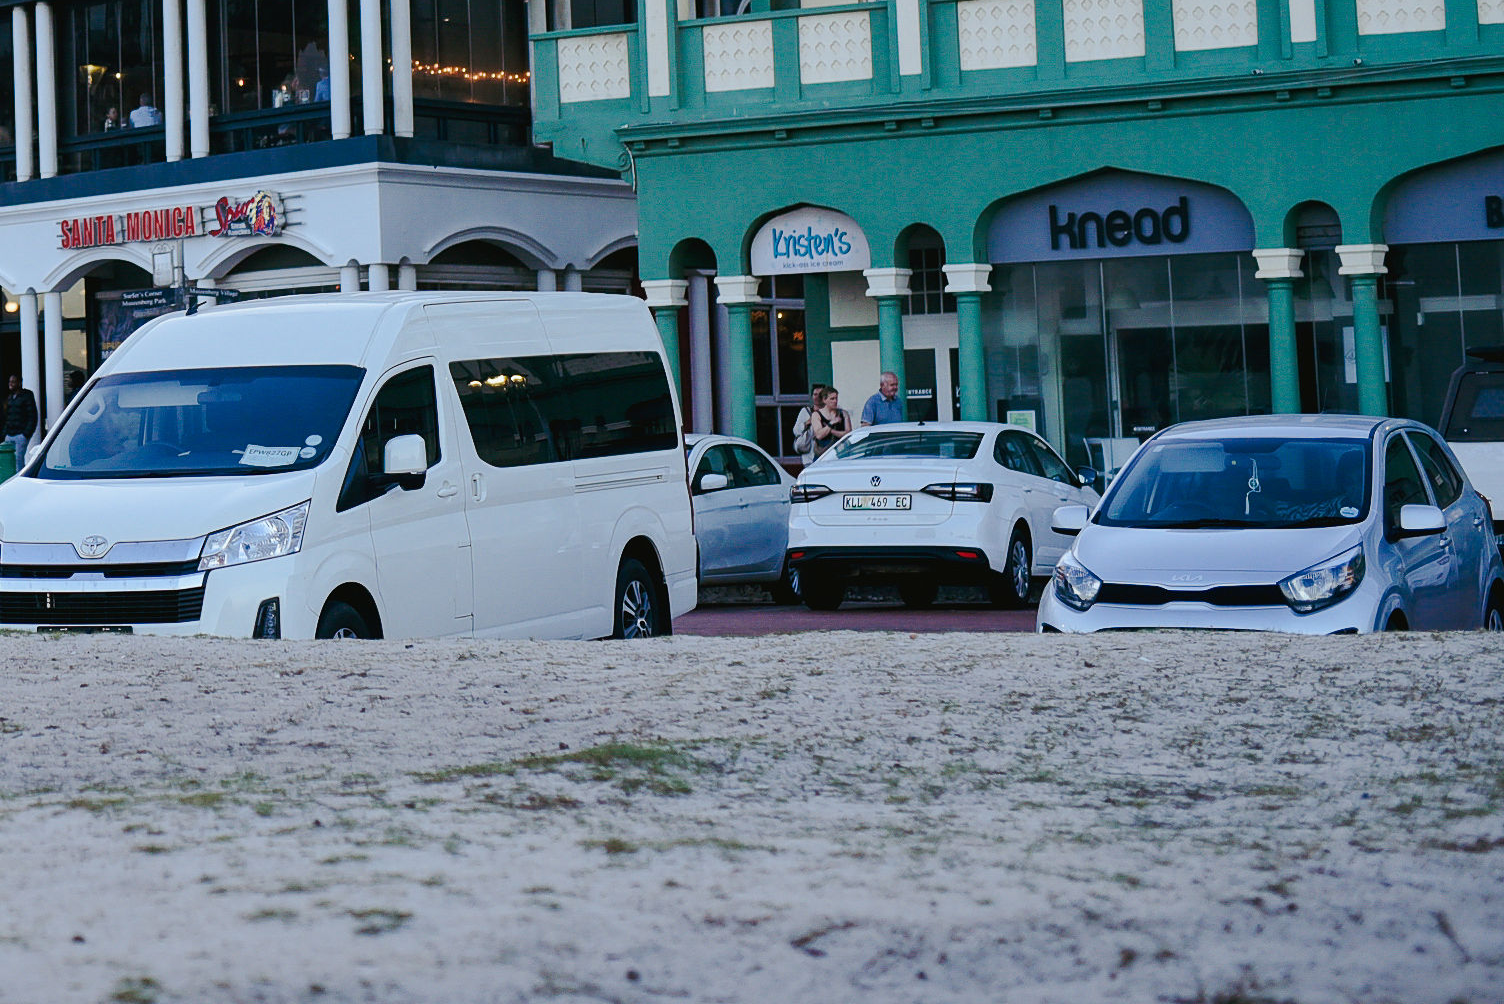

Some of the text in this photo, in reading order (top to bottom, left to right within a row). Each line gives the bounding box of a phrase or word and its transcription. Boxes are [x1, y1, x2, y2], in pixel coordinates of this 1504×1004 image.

[61, 214, 116, 250] SANTA
[126, 206, 195, 242] MONICA
[1048, 196, 1191, 250] knead
[771, 226, 851, 259] Kristen's
[822, 259, 844, 267] cream
[123, 290, 163, 300] Surfer's Corner
[221, 289, 239, 298] Village
[154, 297, 167, 305] Park
[870, 496, 888, 508] 469
[895, 496, 907, 508] EC
